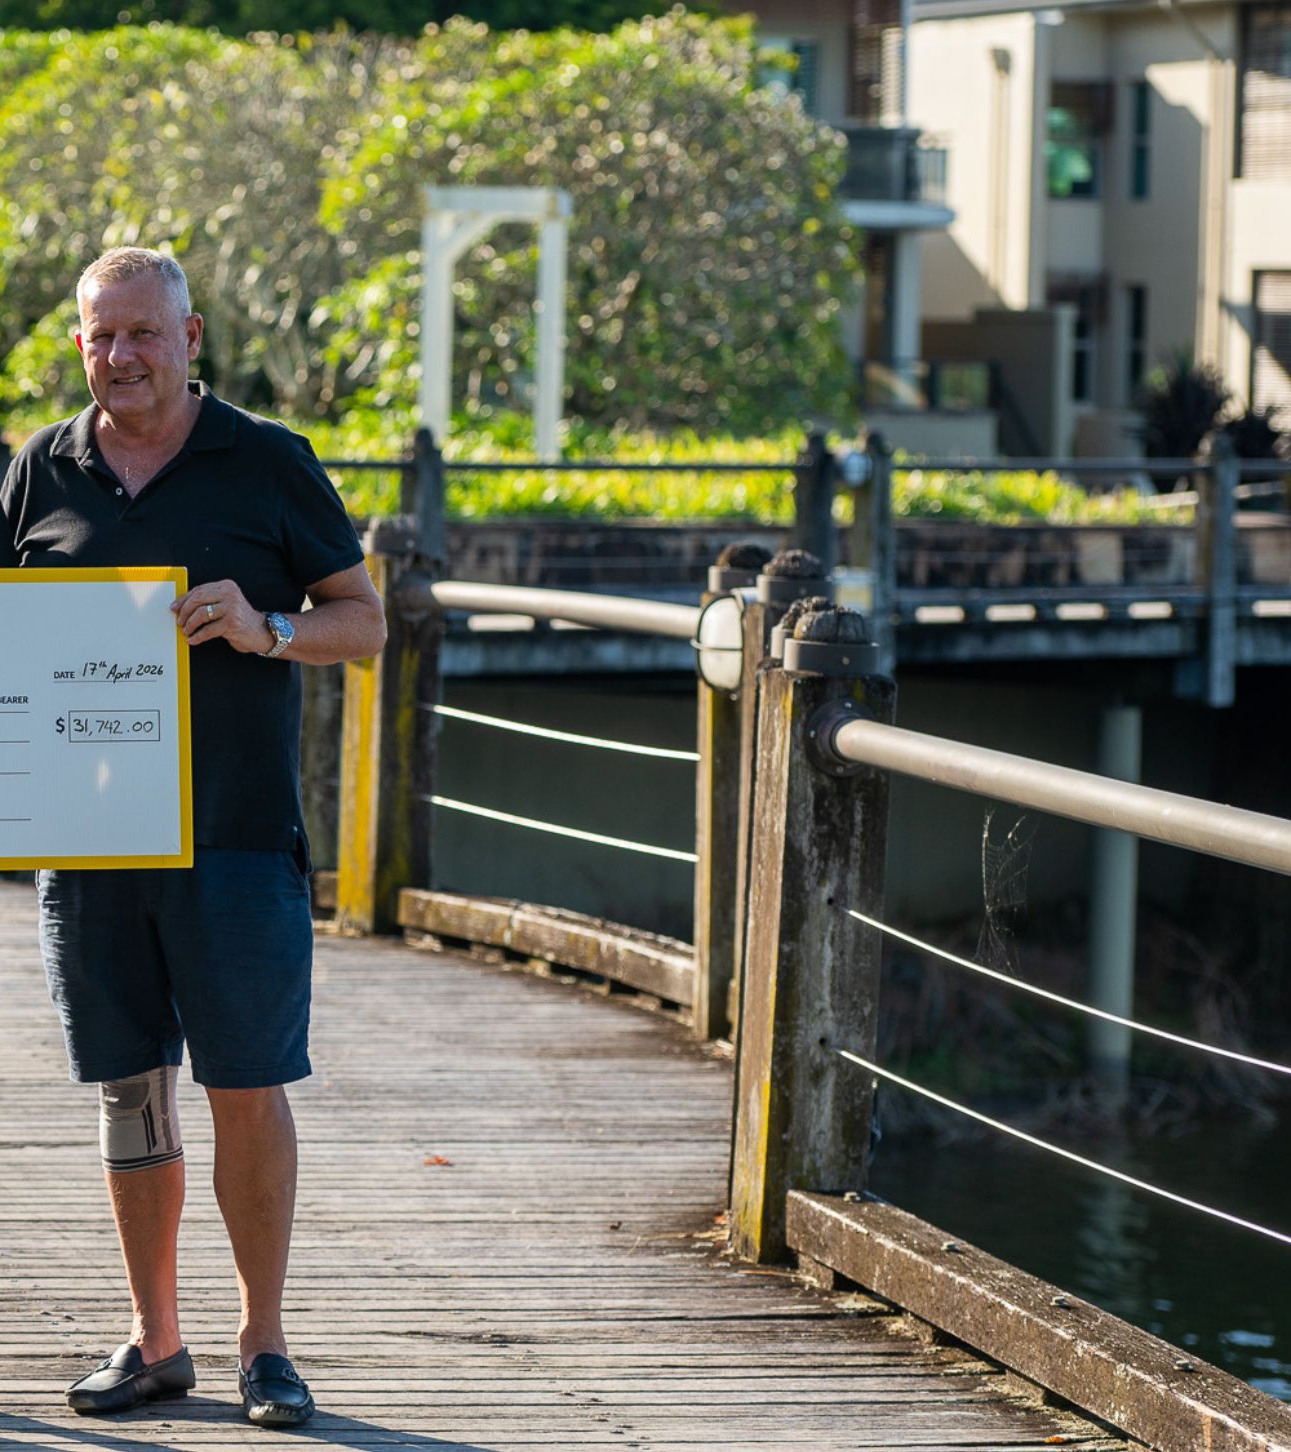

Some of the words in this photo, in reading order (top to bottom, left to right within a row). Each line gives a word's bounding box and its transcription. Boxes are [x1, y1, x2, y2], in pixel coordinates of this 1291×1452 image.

[53, 671, 76, 679] DATE
[106, 664, 132, 683] April
[135, 664, 164, 676] 2026
[55, 716, 65, 734] $
[73, 718, 154, 736] 31,742.00
